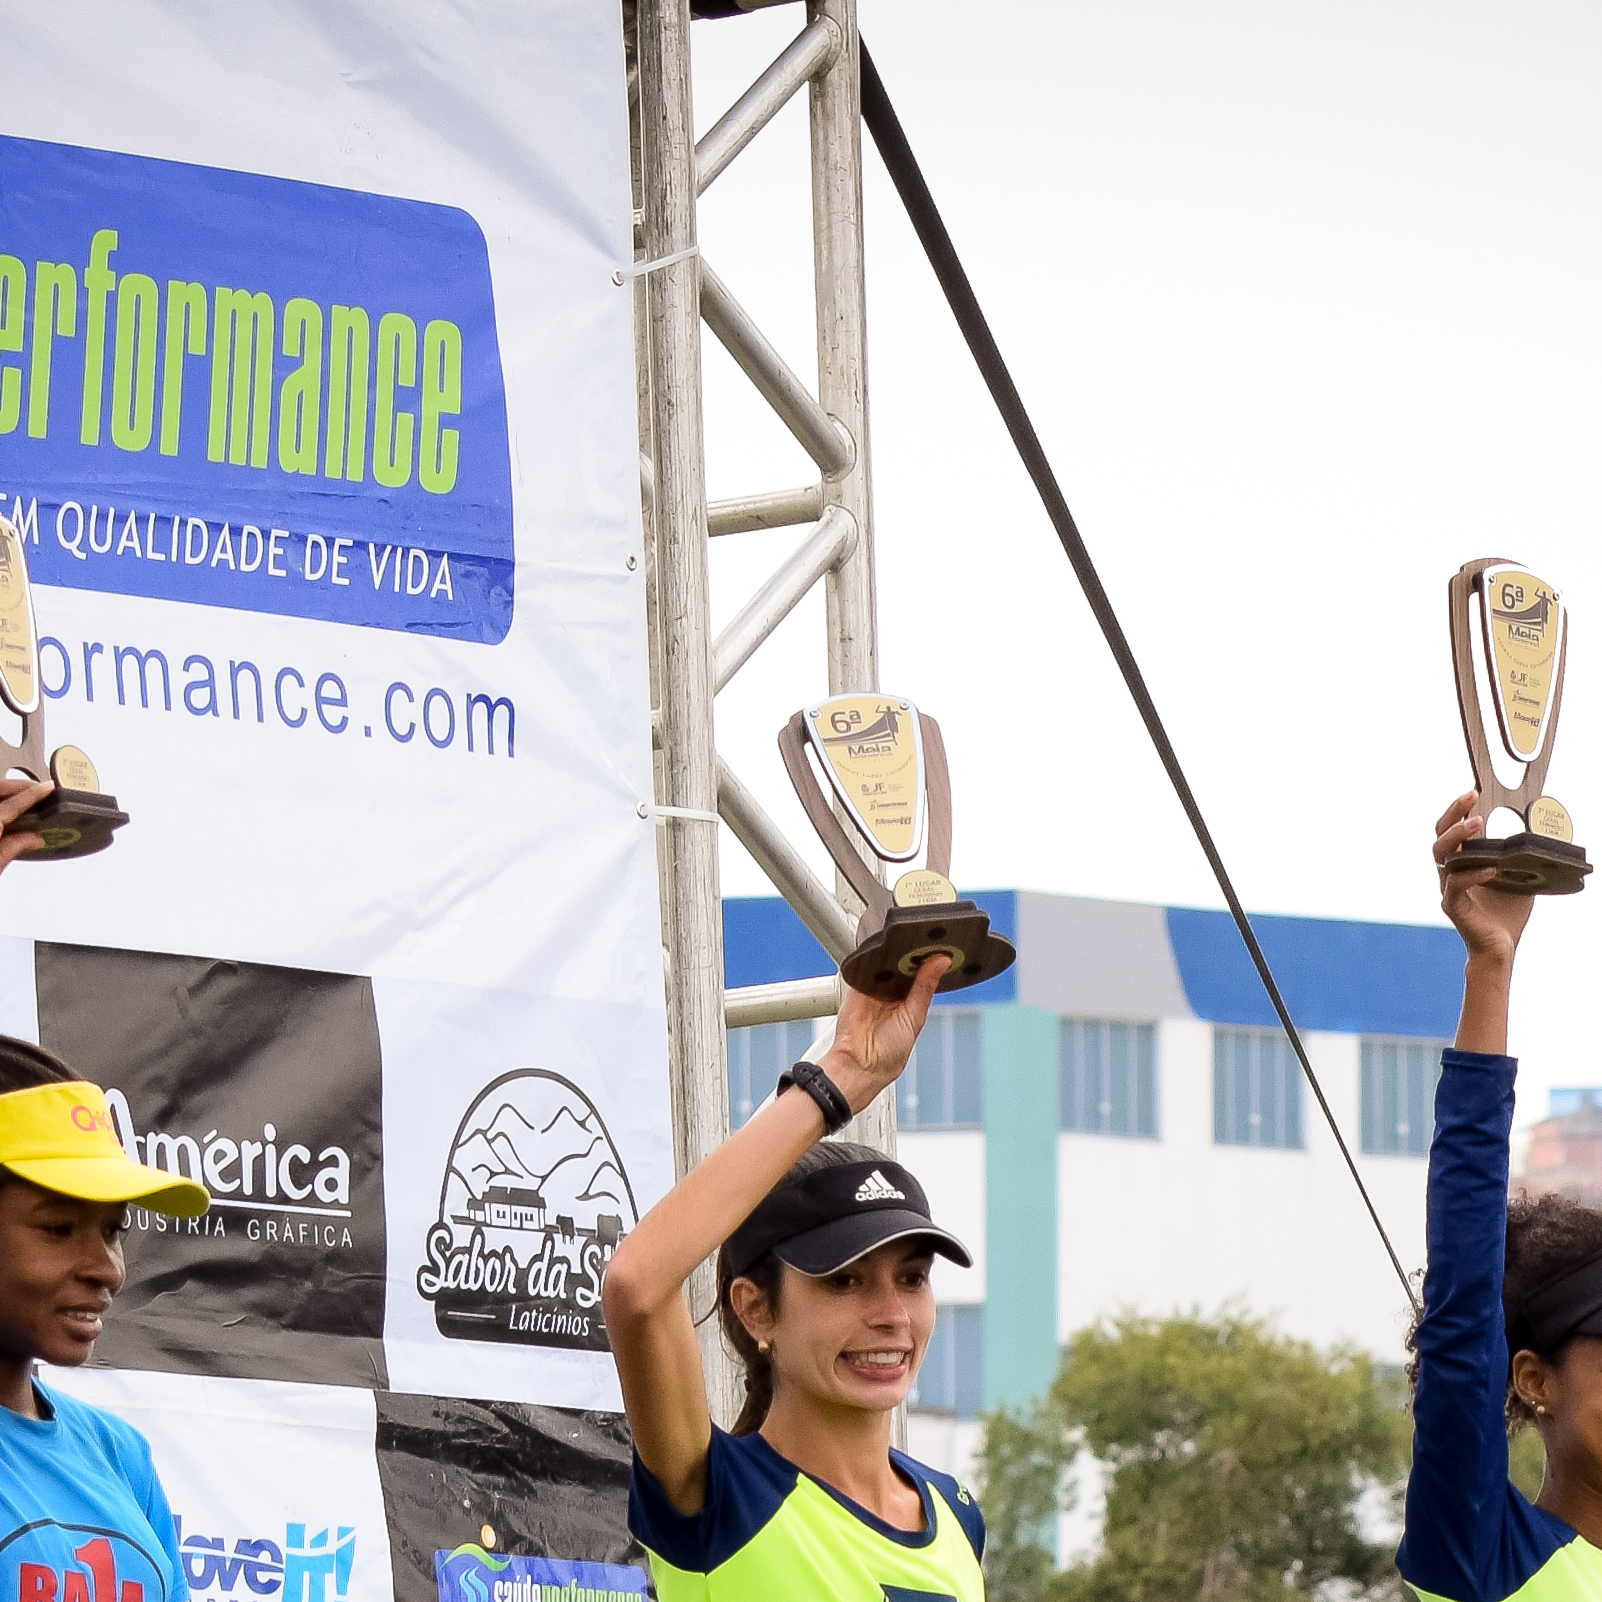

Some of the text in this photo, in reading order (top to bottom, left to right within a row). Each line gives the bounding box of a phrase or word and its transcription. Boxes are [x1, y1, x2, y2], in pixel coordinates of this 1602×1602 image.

[56, 501, 288, 577] QUALIDADE
[304, 533, 349, 585] DE
[367, 548, 456, 601] VIDA
[830, 710, 862, 734] 6ª
[855, 1189, 906, 1201] adidas
[247, 1218, 353, 1248] GRÁFICA
[420, 1229, 517, 1294] Sabor
[527, 1240, 567, 1300] da
[508, 1304, 590, 1337] Laticínios
